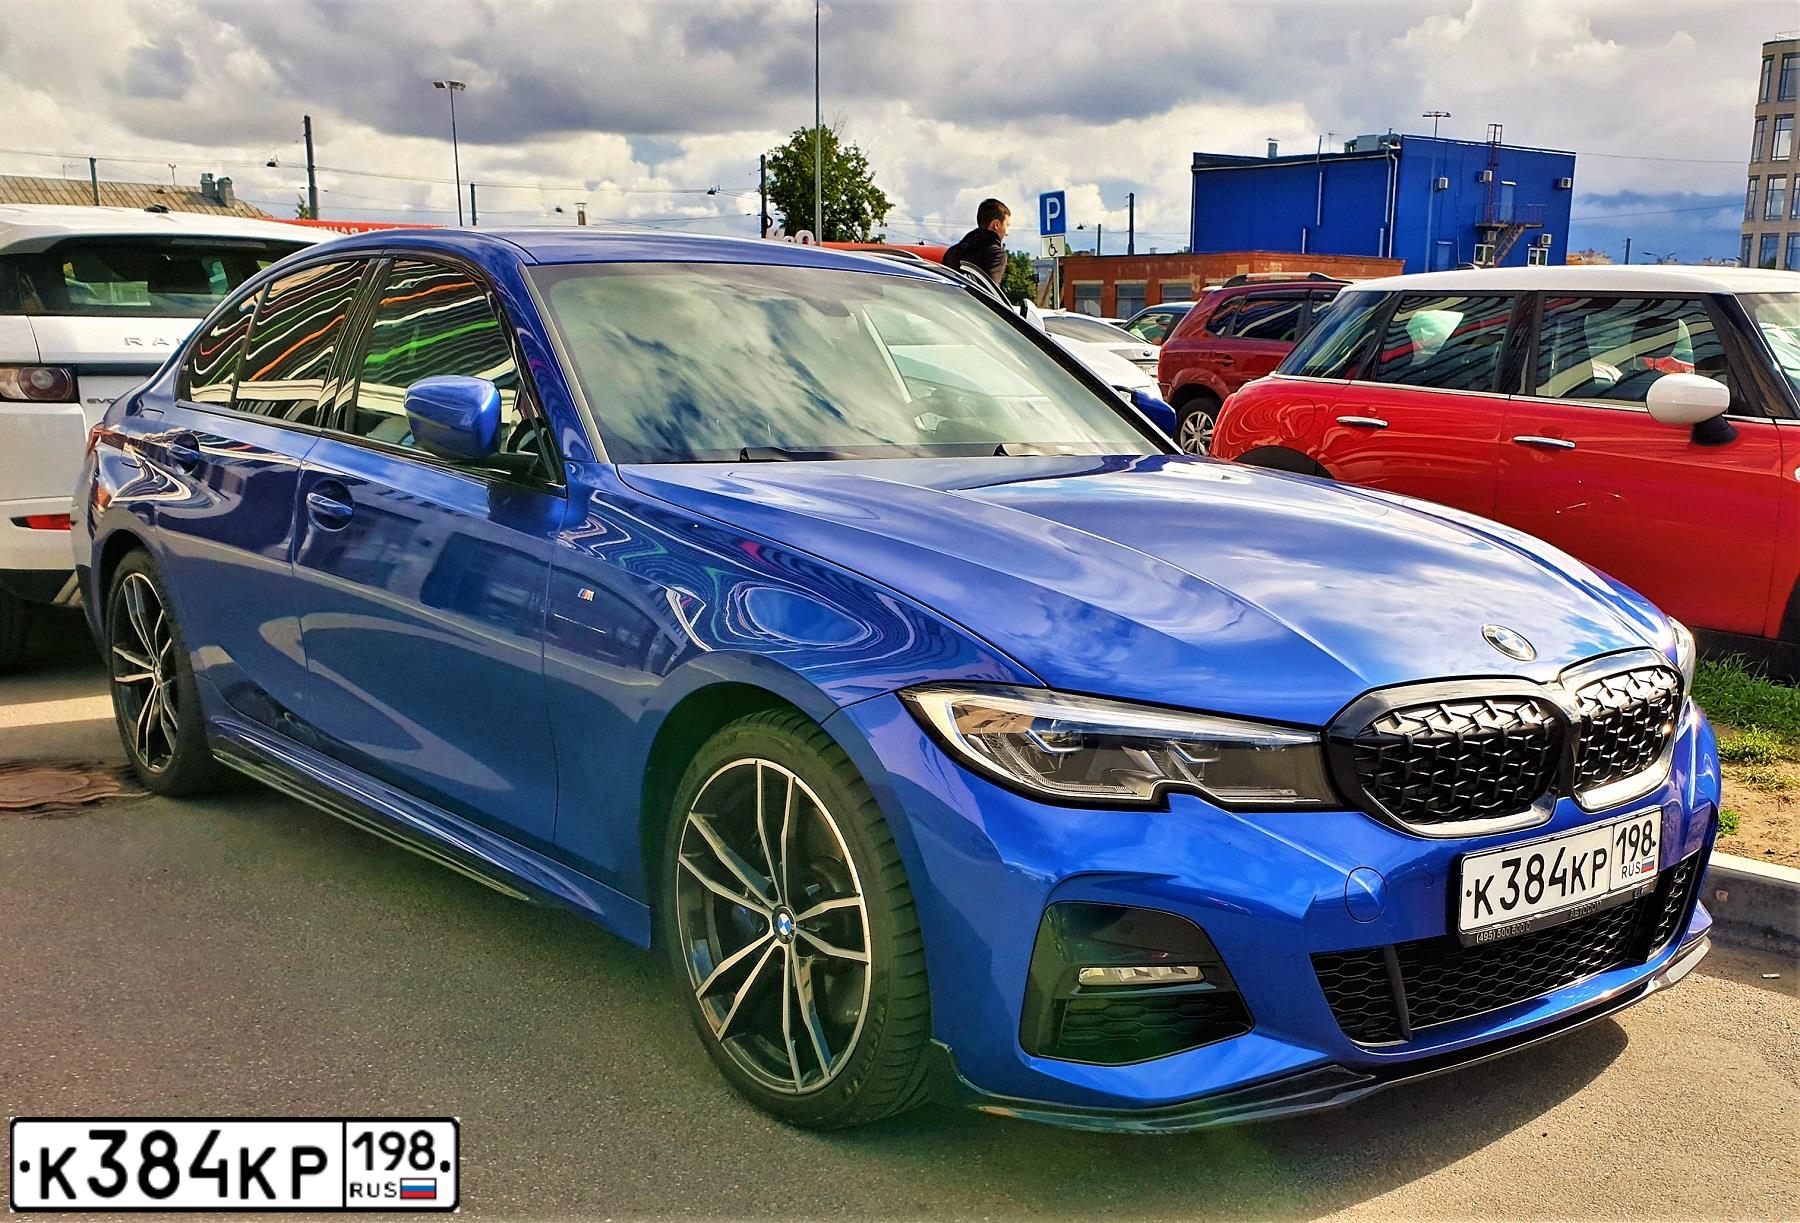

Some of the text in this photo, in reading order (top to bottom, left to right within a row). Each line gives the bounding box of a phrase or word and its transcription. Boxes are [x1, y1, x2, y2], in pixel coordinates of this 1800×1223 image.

[1046, 197, 1061, 231] P
[1615, 819, 1653, 865] 198
[1621, 861, 1641, 880] RUS
